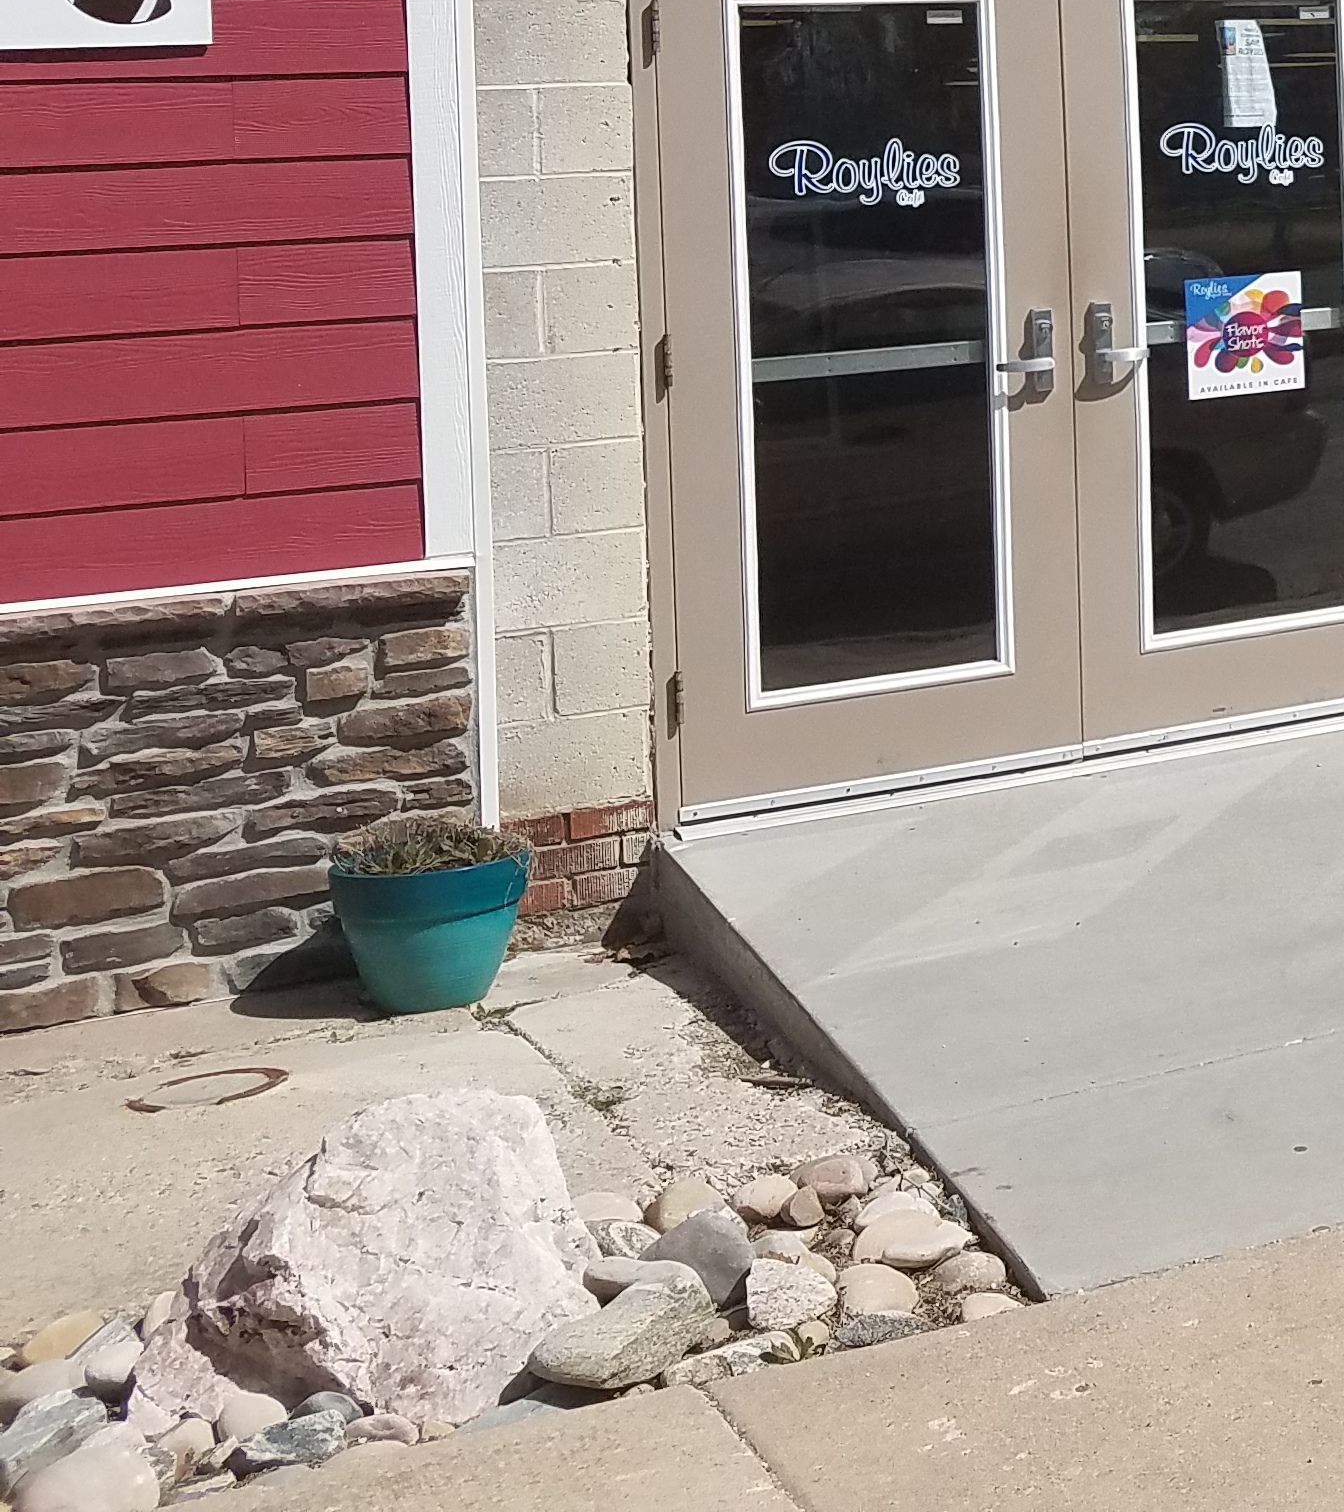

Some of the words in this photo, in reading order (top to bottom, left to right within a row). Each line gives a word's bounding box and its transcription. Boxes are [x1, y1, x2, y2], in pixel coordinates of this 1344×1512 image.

[1160, 122, 1324, 184] Roylies
[769, 138, 960, 205] Roylies
[1225, 322, 1266, 337] Flavor
[1227, 336, 1265, 351] Shots
[1200, 381, 1253, 394] AVAILABLE
[1258, 379, 1269, 387] IN
